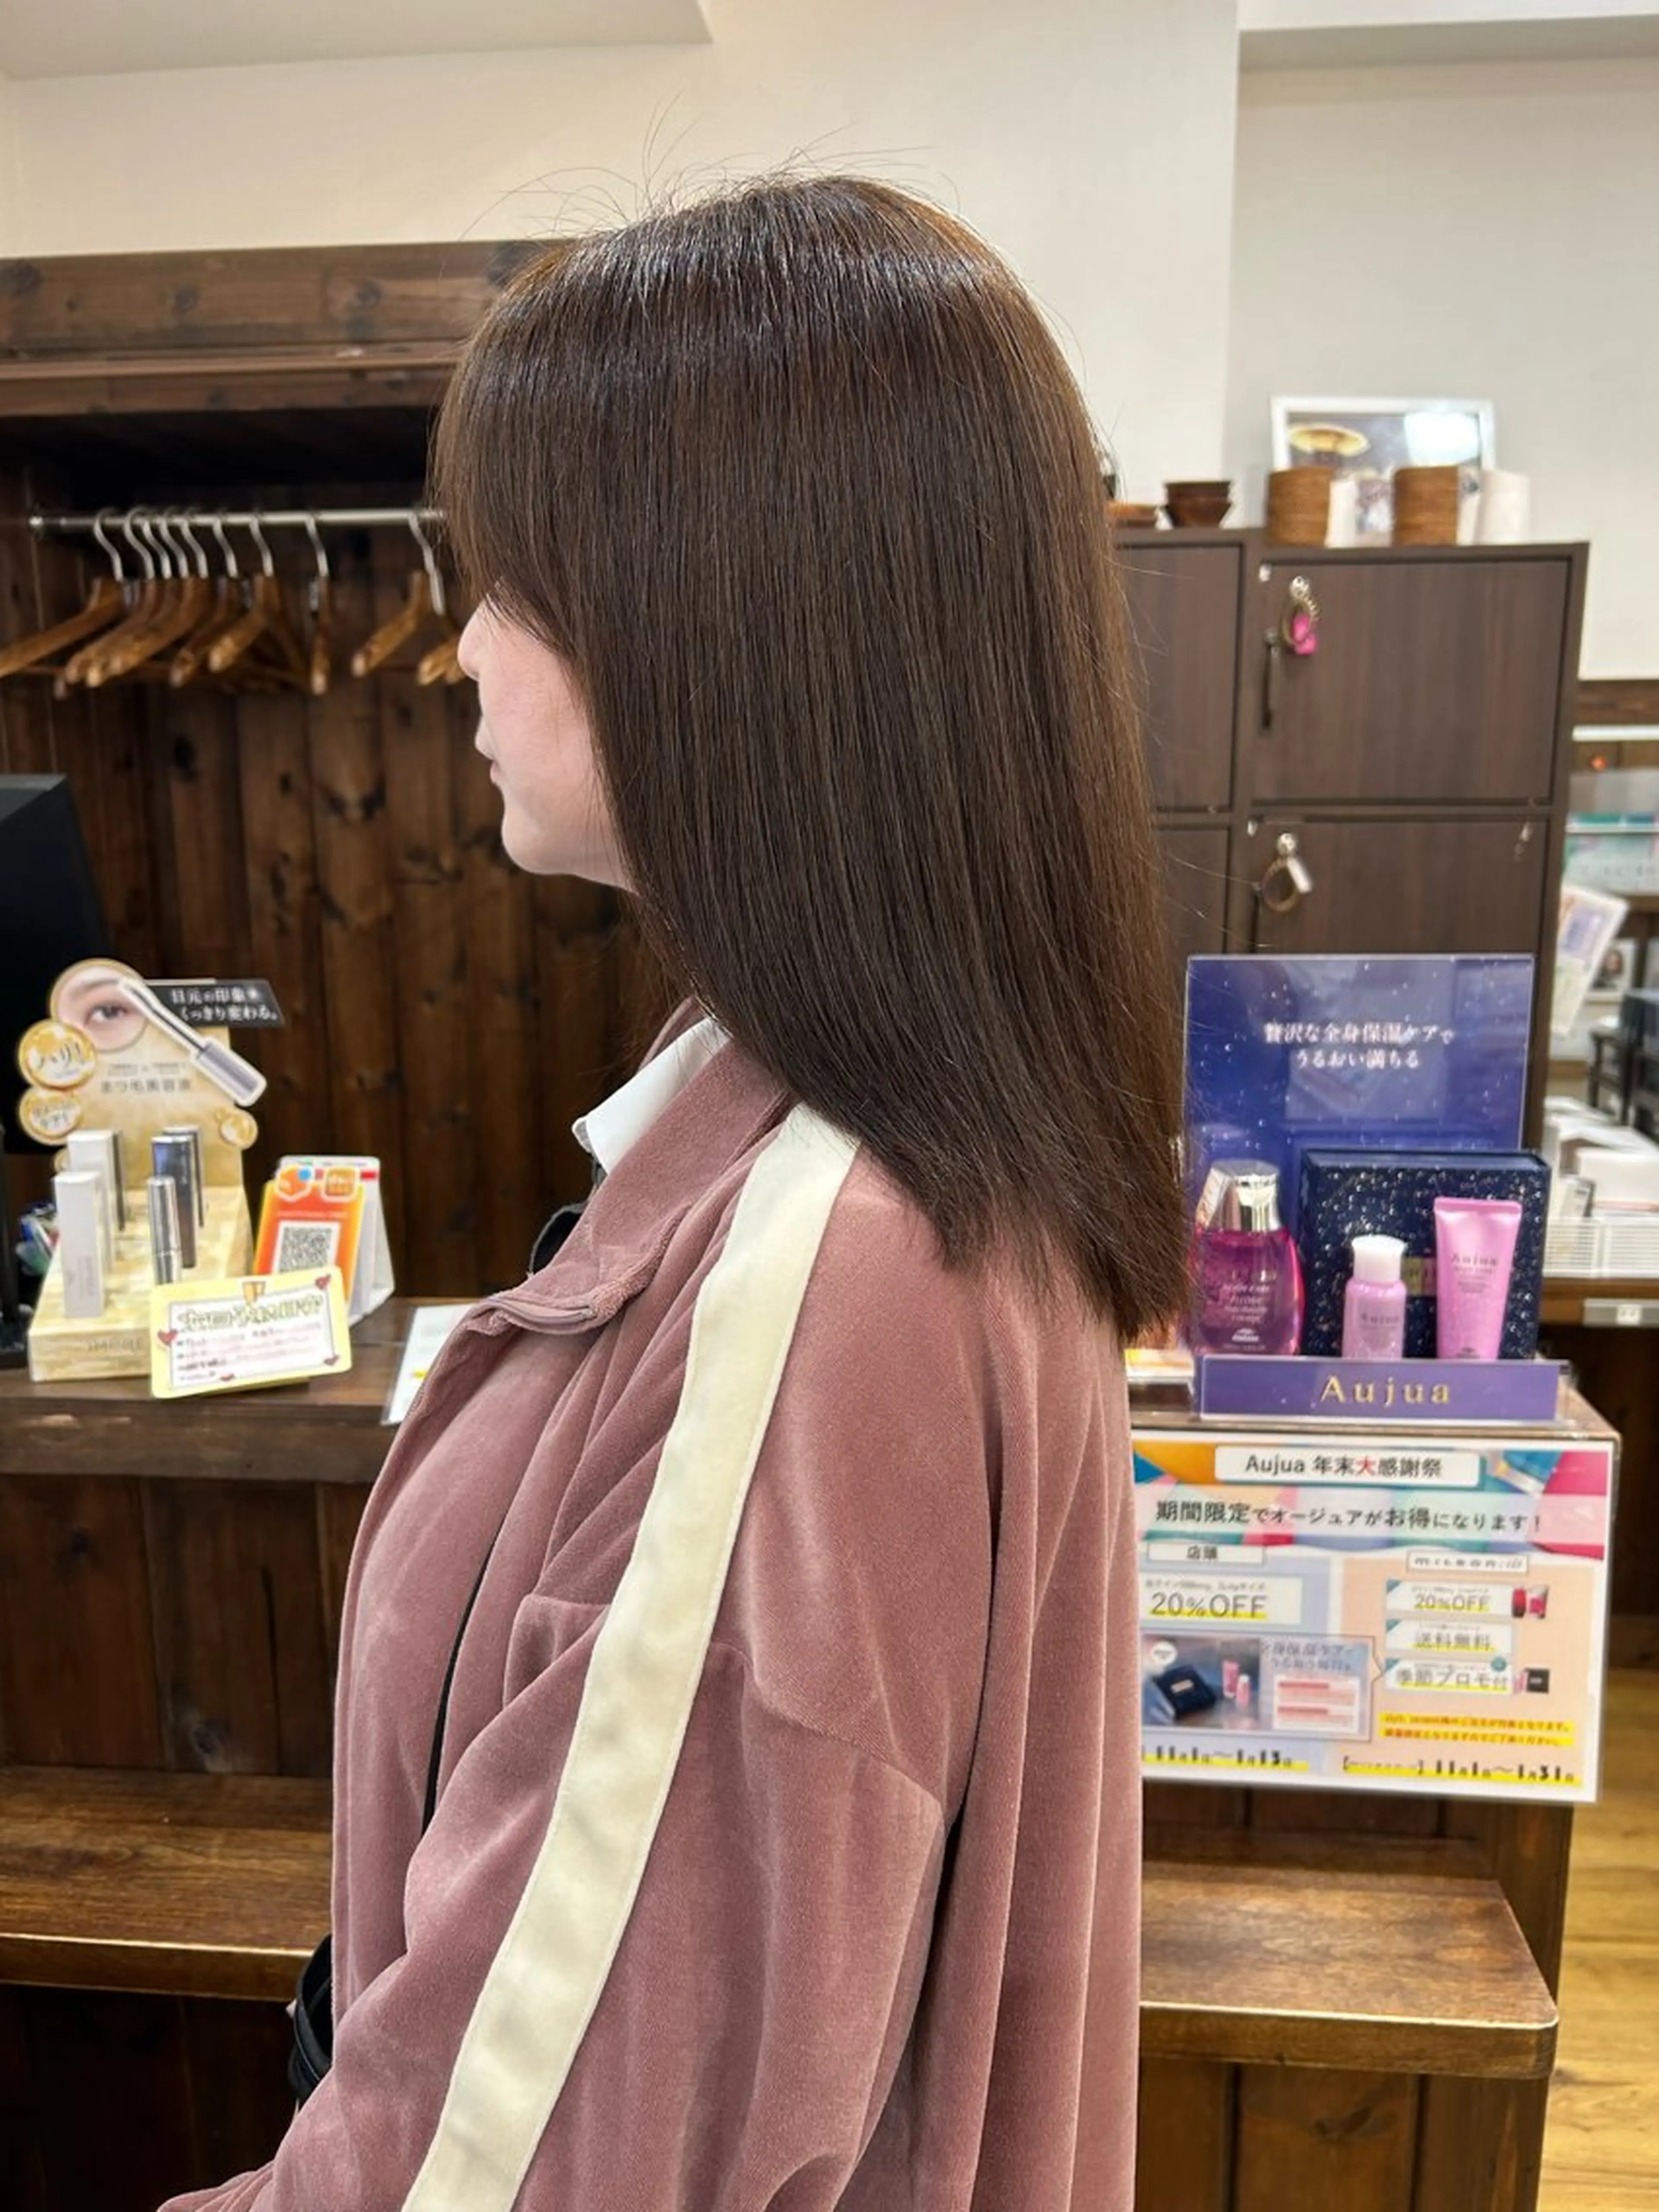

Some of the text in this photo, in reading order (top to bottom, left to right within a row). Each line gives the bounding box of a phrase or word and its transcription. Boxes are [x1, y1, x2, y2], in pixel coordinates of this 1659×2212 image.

[1320, 1374, 1449, 1408] Aujua
[1245, 1453, 1442, 1478] Aujua 年末大感謝祭
[1150, 1591, 1268, 1619] 20%OFF
[1414, 1594, 1491, 1612] 20%OFF
